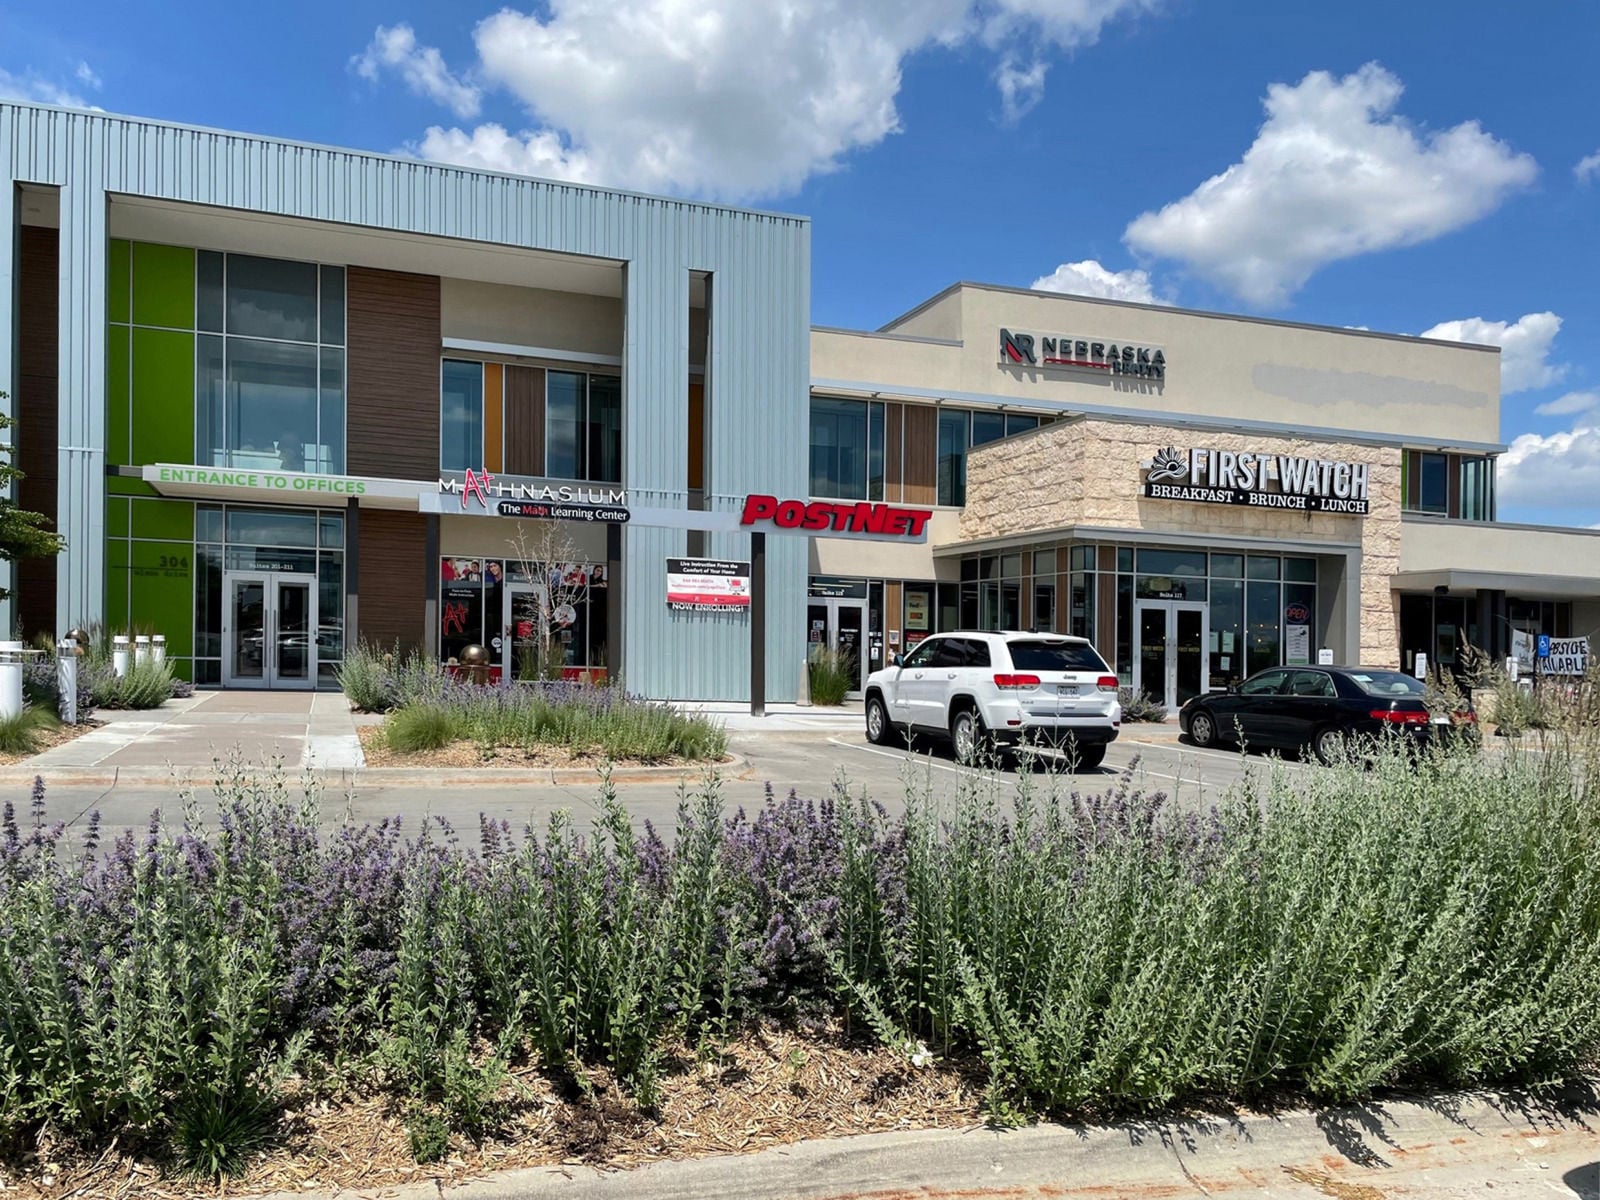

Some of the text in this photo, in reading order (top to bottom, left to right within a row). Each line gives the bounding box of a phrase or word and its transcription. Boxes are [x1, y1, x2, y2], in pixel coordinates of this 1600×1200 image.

[1042, 337, 1166, 364] NEBRASKA
[1112, 360, 1166, 378] REALTY
[159, 467, 366, 494] ENTRANCE TO OFFICES
[1190, 447, 1369, 500] FIRST WATCH
[501, 503, 627, 521] The Math Learning Center
[1151, 484, 1366, 514] BREAKFAST BRUNCH LUNCH
[672, 602, 694, 611] NOW
